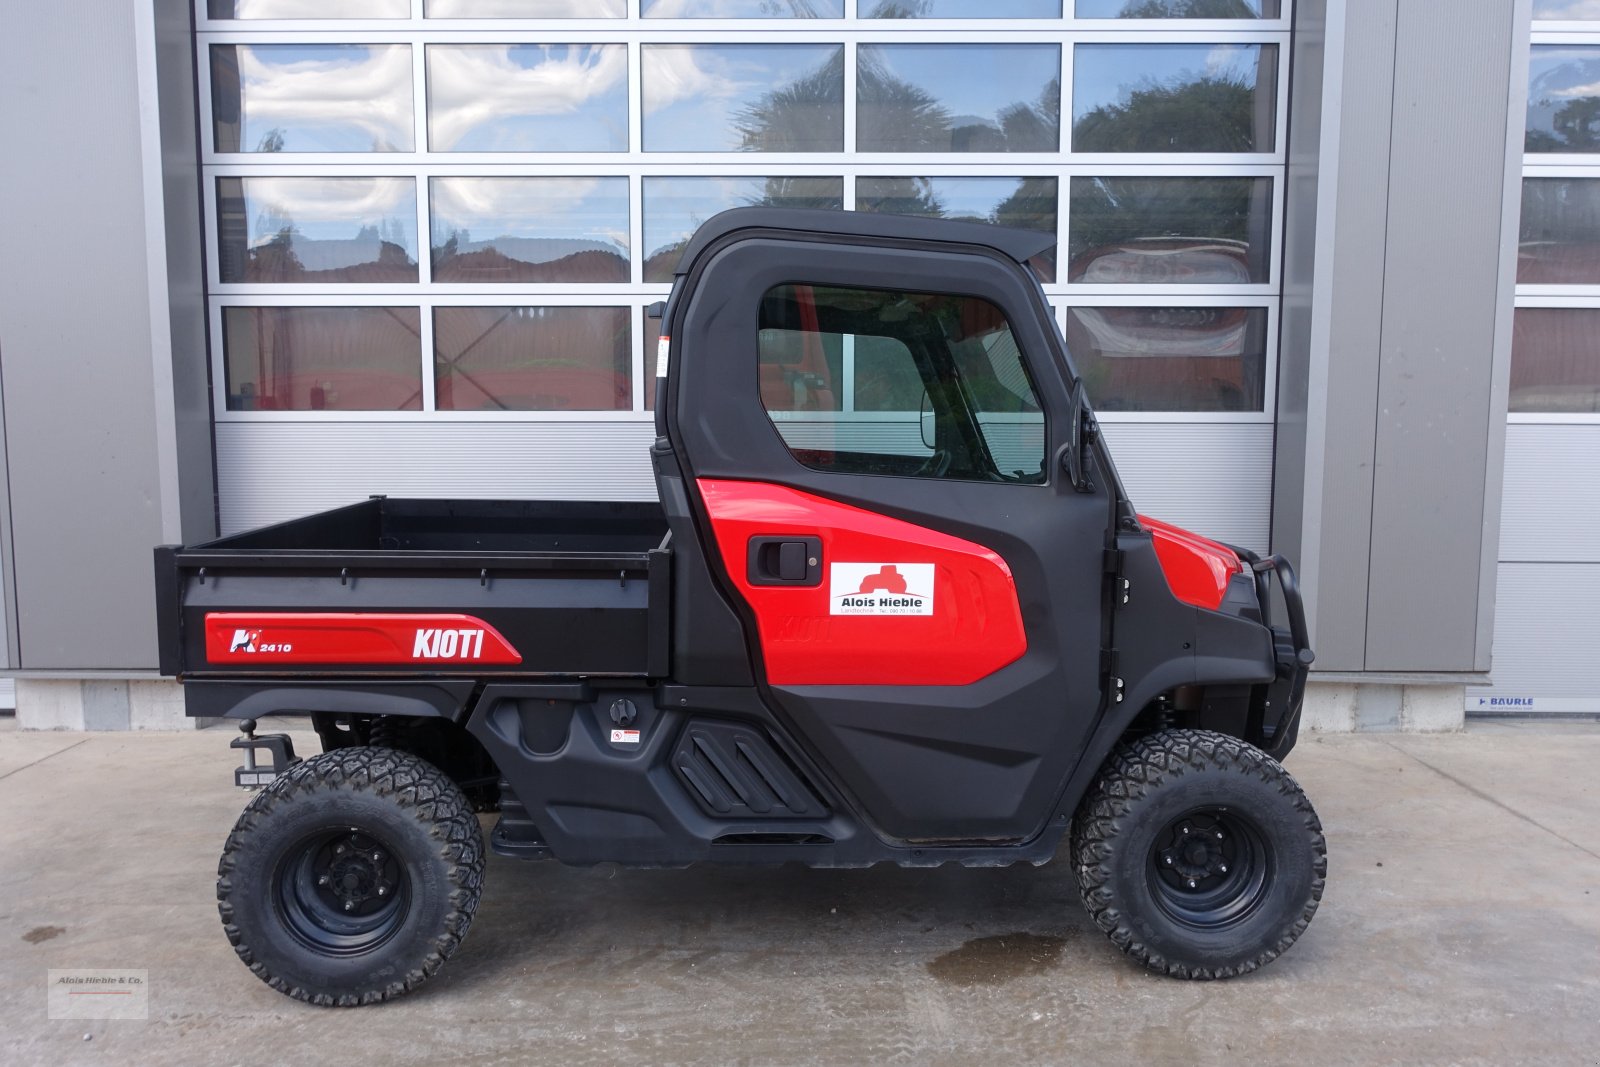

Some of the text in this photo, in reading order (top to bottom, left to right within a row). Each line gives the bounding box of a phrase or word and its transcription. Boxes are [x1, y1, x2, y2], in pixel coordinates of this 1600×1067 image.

[841, 597, 923, 607] Alois Hieble
[412, 628, 485, 658] KIOTI
[260, 644, 292, 653] 2410
